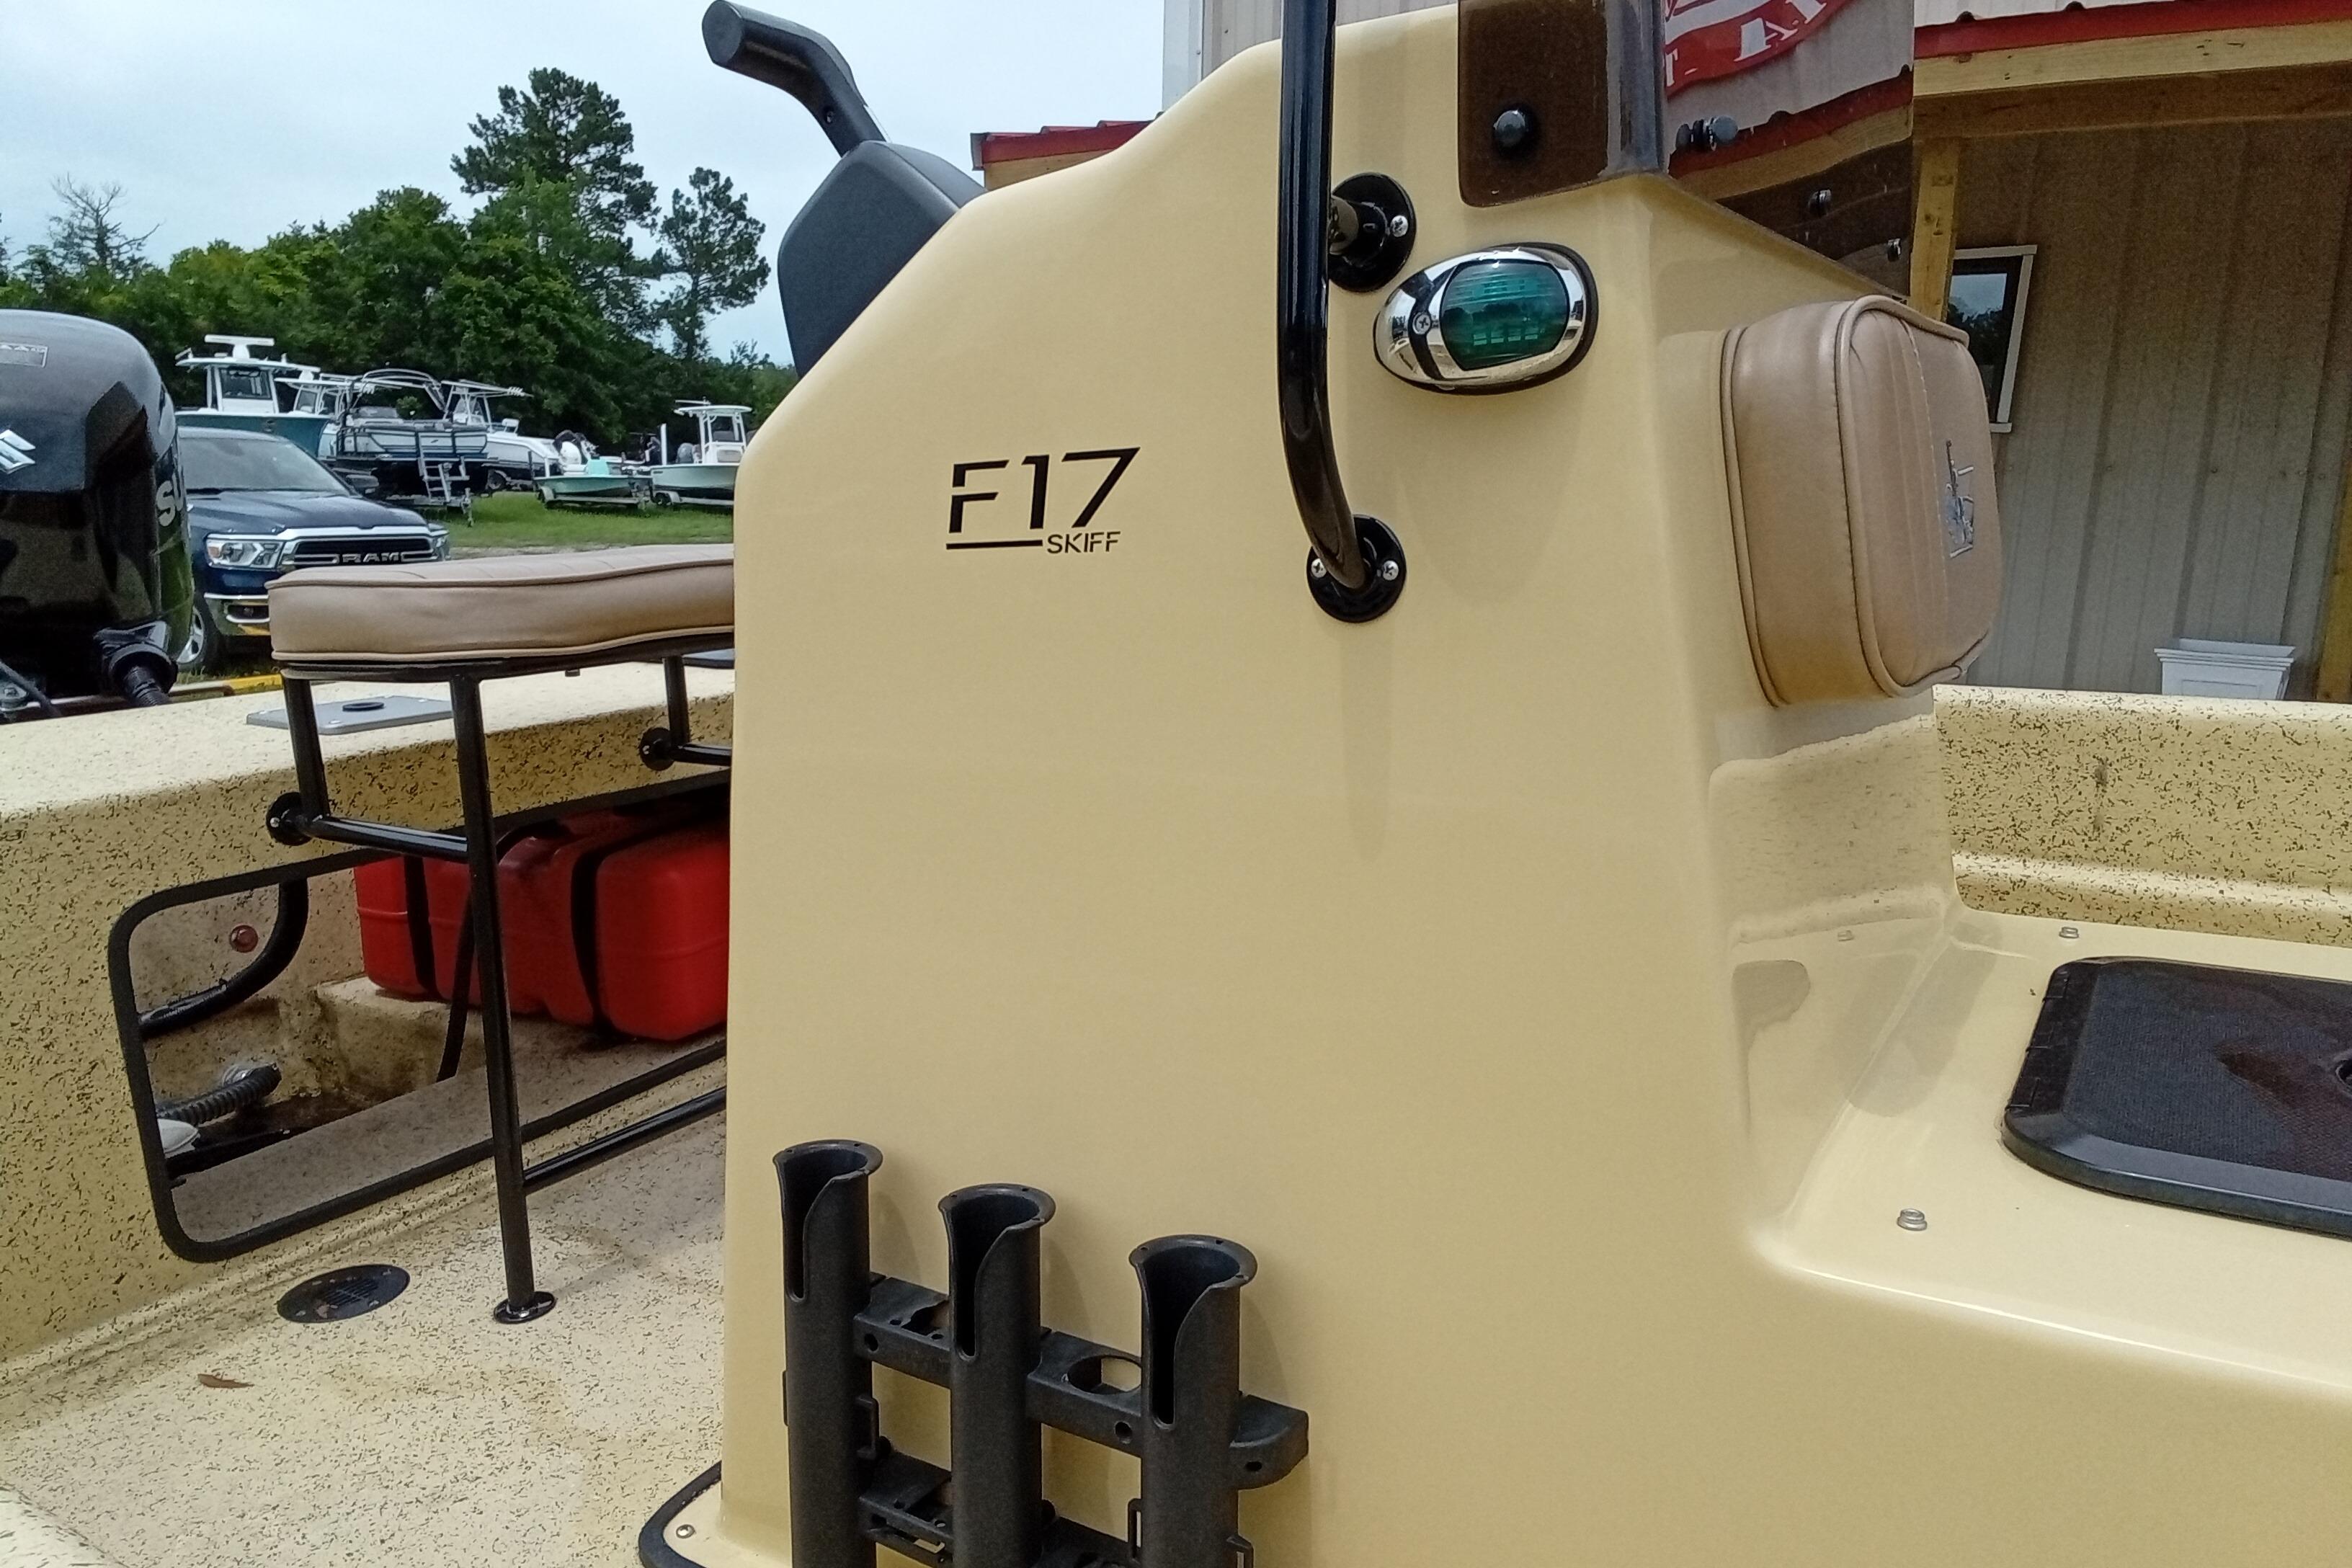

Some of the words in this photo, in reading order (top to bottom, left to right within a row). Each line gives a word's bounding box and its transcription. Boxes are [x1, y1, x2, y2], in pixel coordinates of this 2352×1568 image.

[949, 447, 1140, 533] F17
[1047, 531, 1121, 554] SKIFF
[342, 552, 399, 564] RAM
